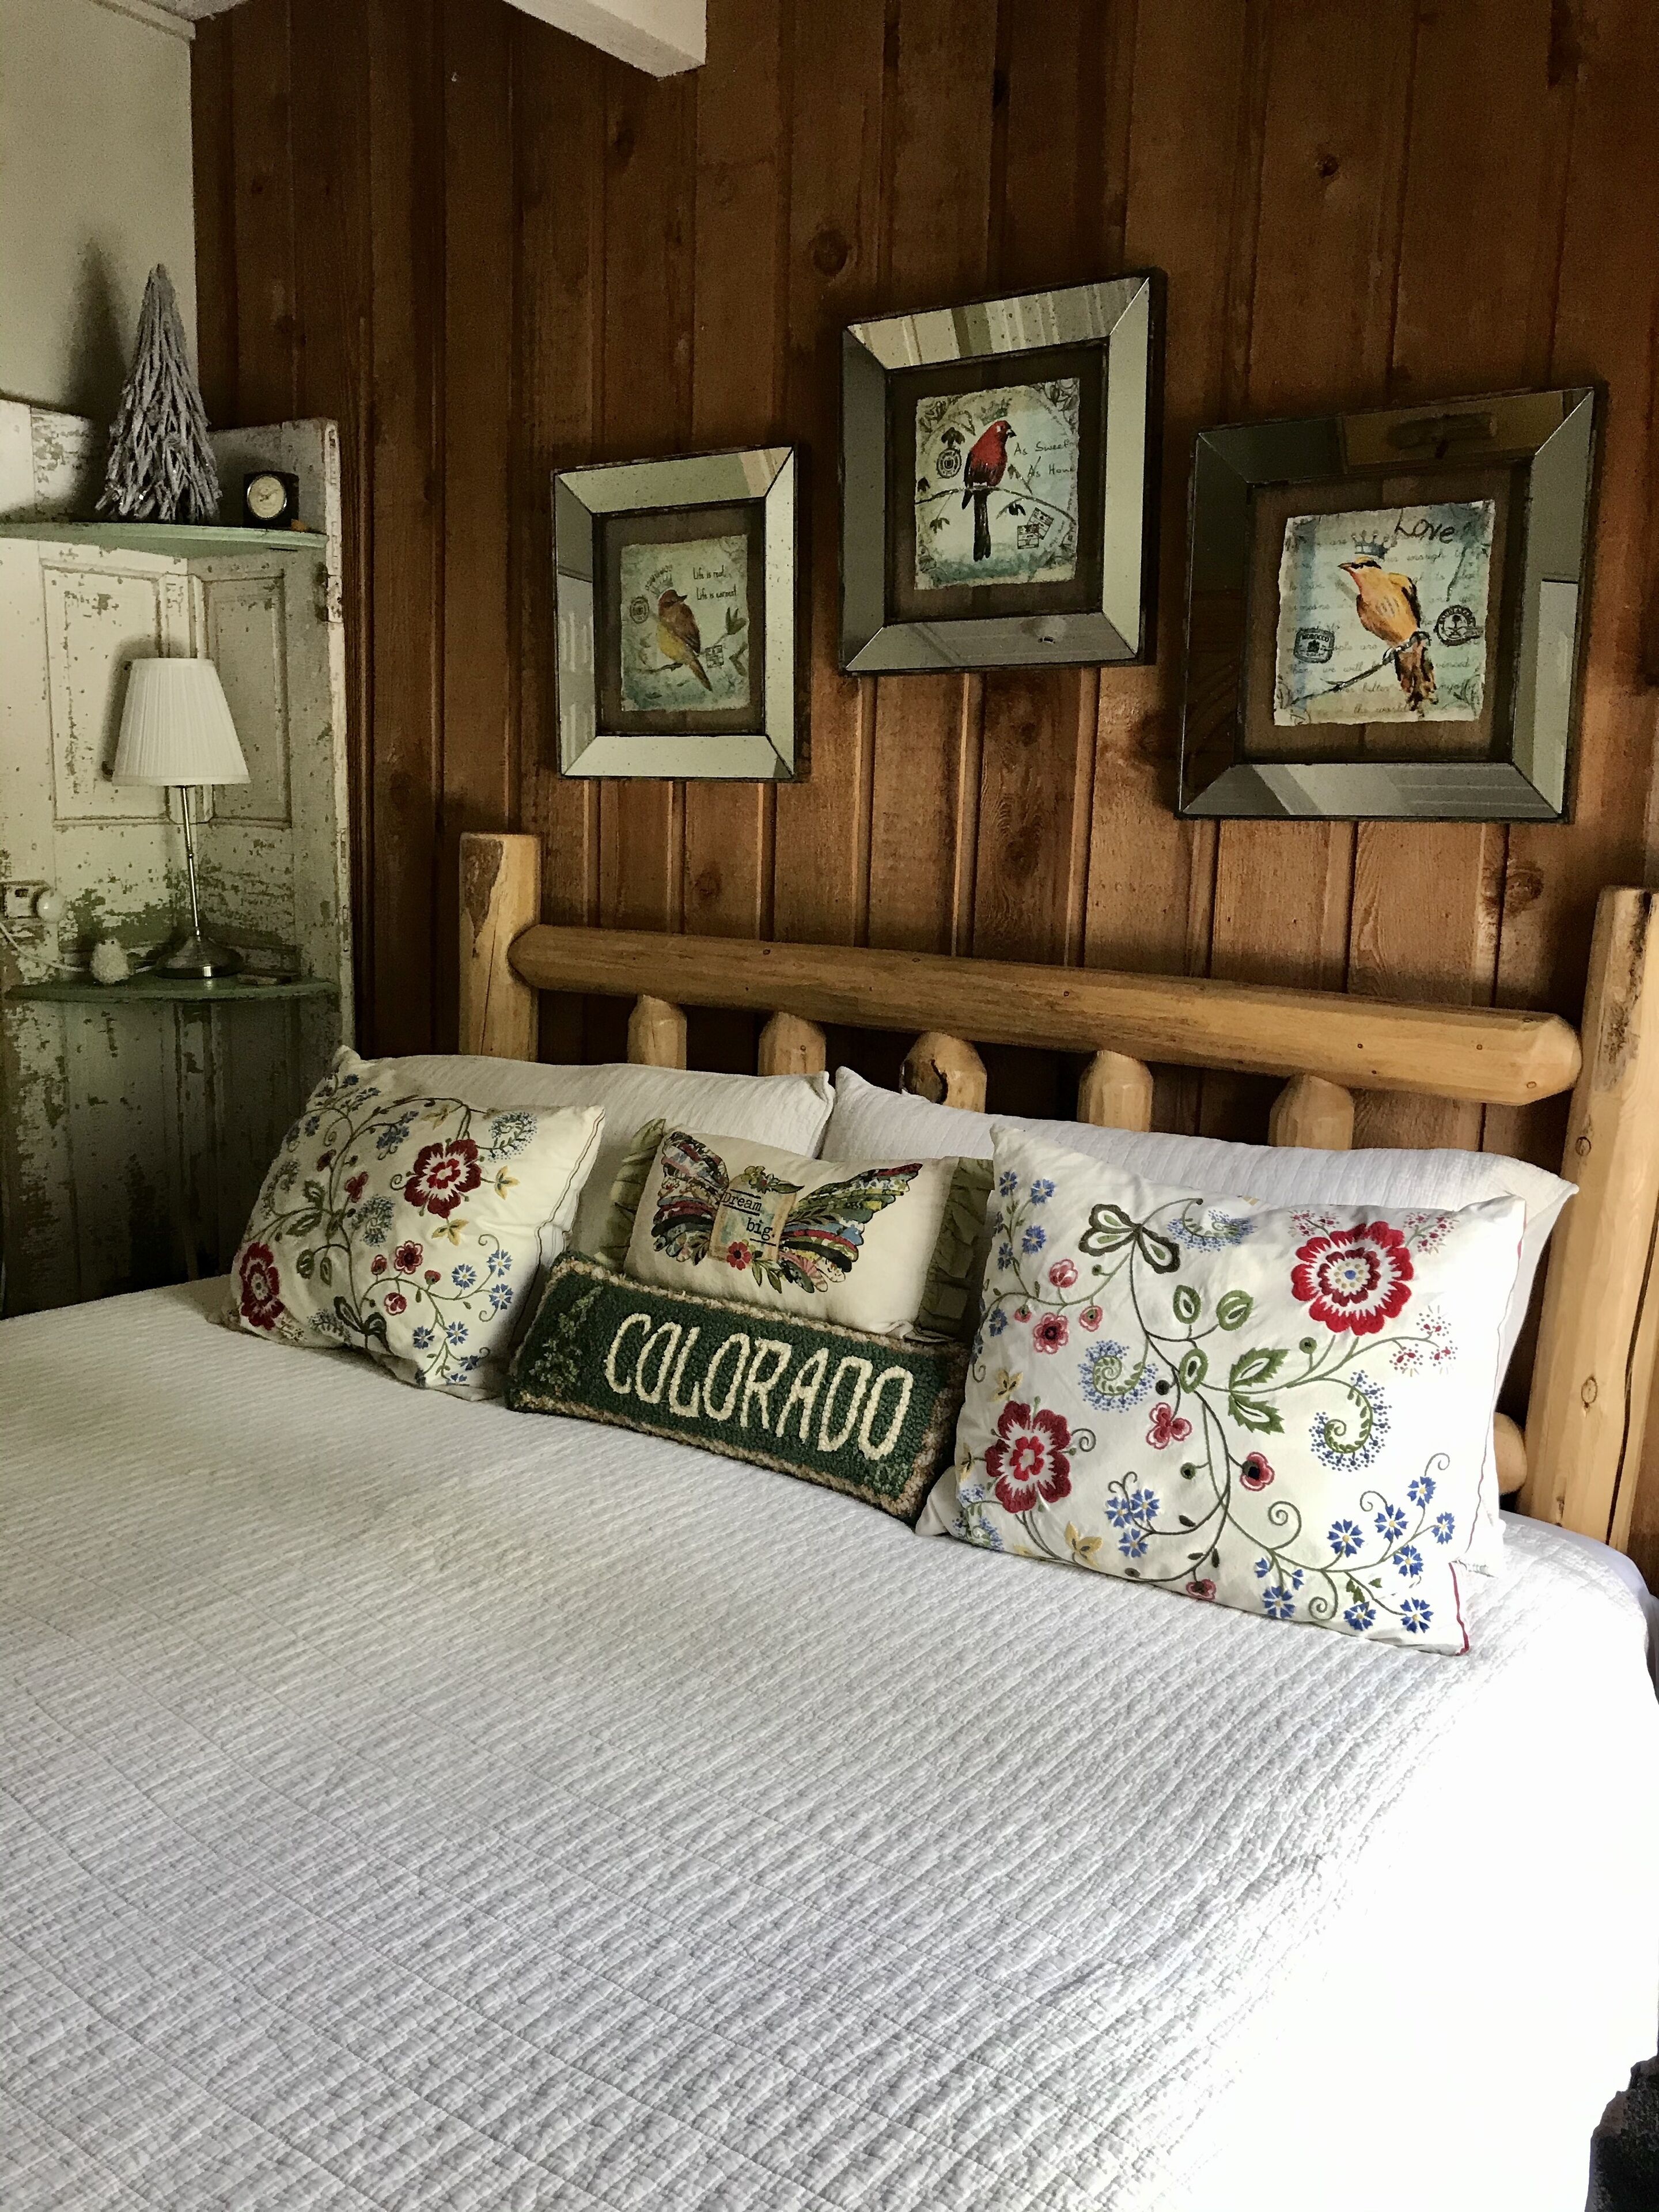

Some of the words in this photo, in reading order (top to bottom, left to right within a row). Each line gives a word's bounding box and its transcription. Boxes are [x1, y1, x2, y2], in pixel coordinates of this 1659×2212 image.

[1014, 442, 1028, 456] As
[1035, 441, 1069, 452] Sweet
[1027, 464, 1040, 478] As
[1395, 508, 1455, 544] Love
[696, 586, 708, 600] Life
[720, 1191, 762, 1211] Dream
[746, 1217, 775, 1241] big.
[604, 1313, 914, 1460] COLORADO
